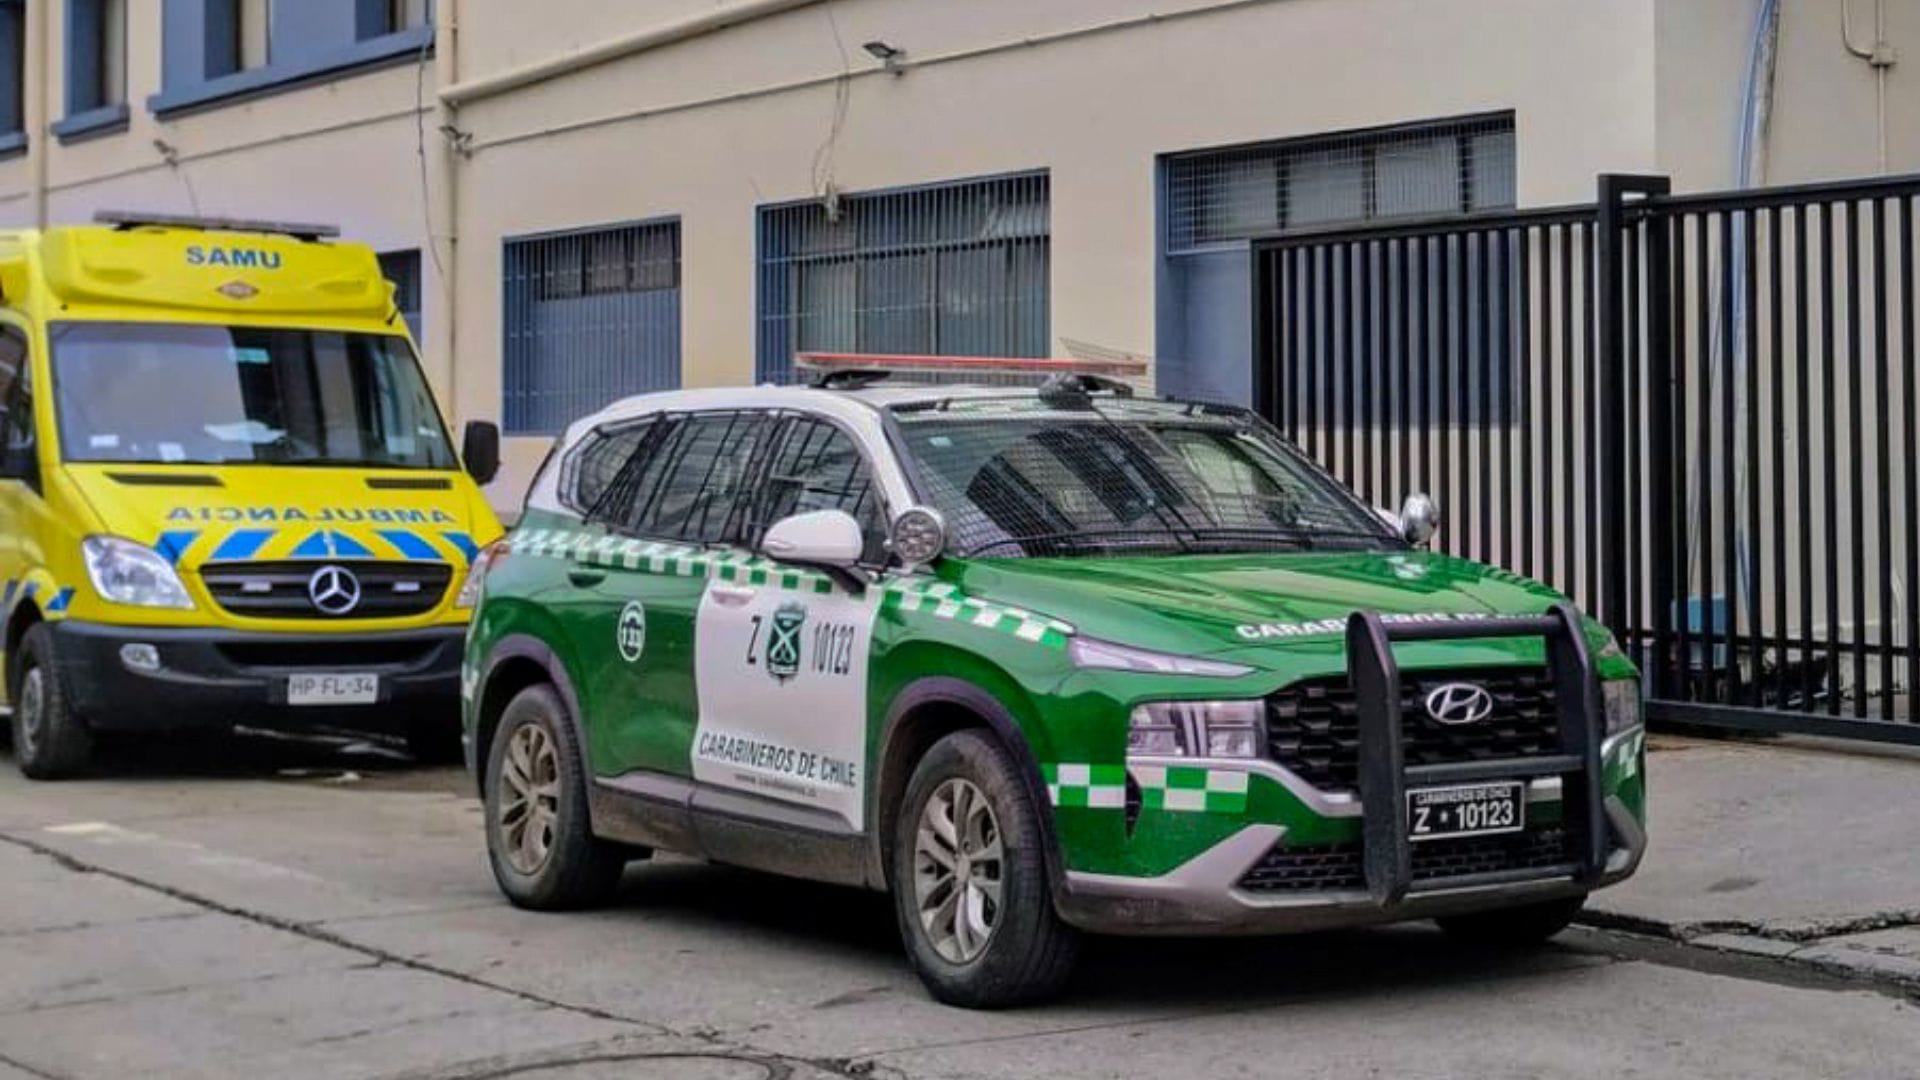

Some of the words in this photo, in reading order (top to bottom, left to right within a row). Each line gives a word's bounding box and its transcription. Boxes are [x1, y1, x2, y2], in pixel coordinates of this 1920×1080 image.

[186, 246, 280, 269] SAMU
[747, 615, 761, 664] Z
[813, 622, 855, 675] 10123
[700, 732, 795, 773] CARABINEROS
[797, 751, 816, 779] DE
[821, 756, 856, 787] CHILE
[1414, 807, 1431, 833] Z
[1455, 799, 1514, 829] 10123
